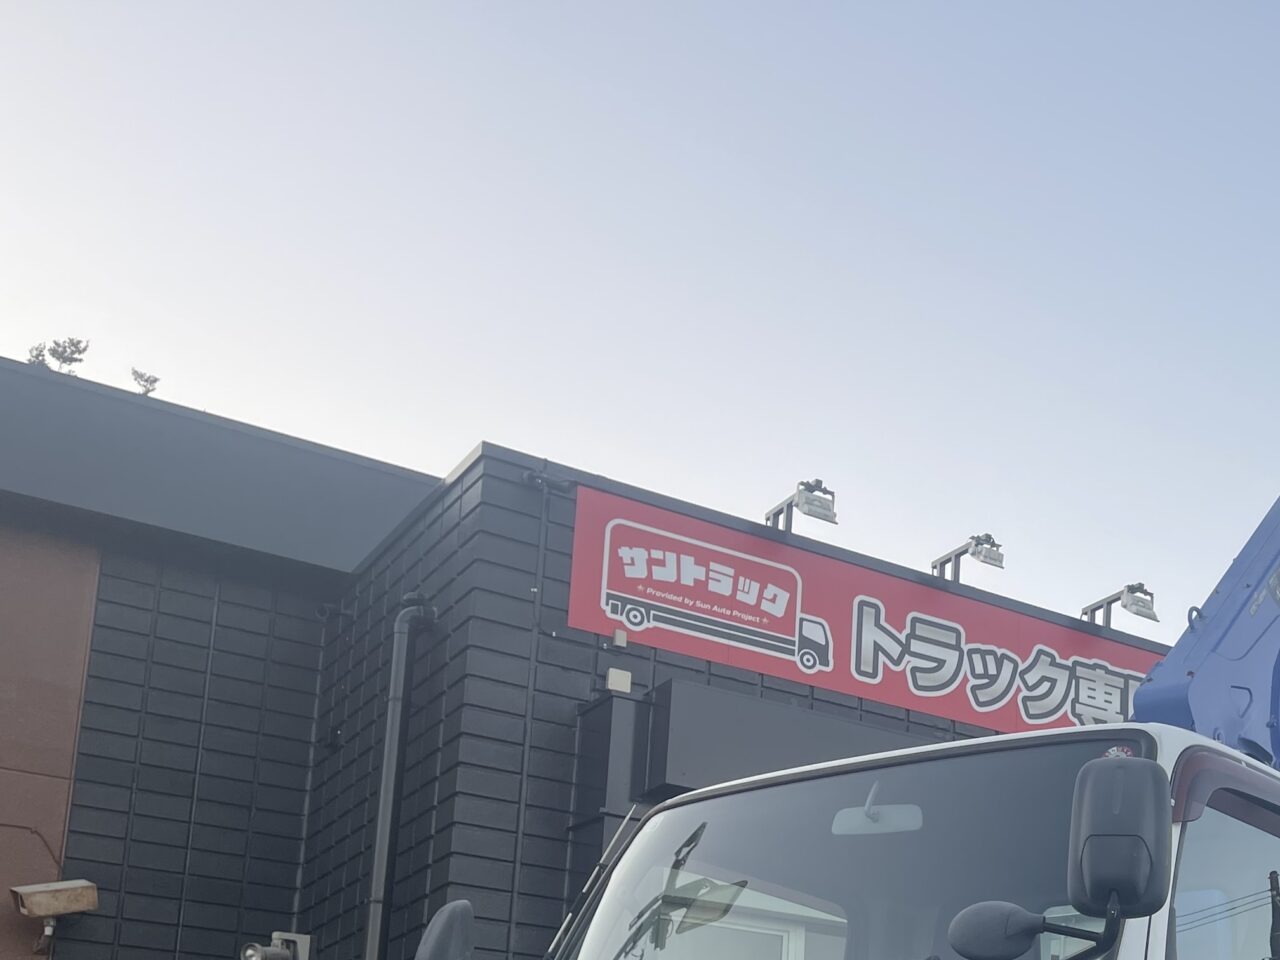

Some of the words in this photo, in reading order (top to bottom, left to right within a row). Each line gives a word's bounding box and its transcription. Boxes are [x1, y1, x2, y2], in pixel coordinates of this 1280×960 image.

[617, 546, 790, 618] サントラック
[646, 587, 683, 603] Provided
[684, 597, 694, 607] by
[695, 599, 711, 610] Sun
[712, 604, 731, 616] Auto
[732, 609, 761, 624] Project
[851, 595, 1148, 728] トラック専
